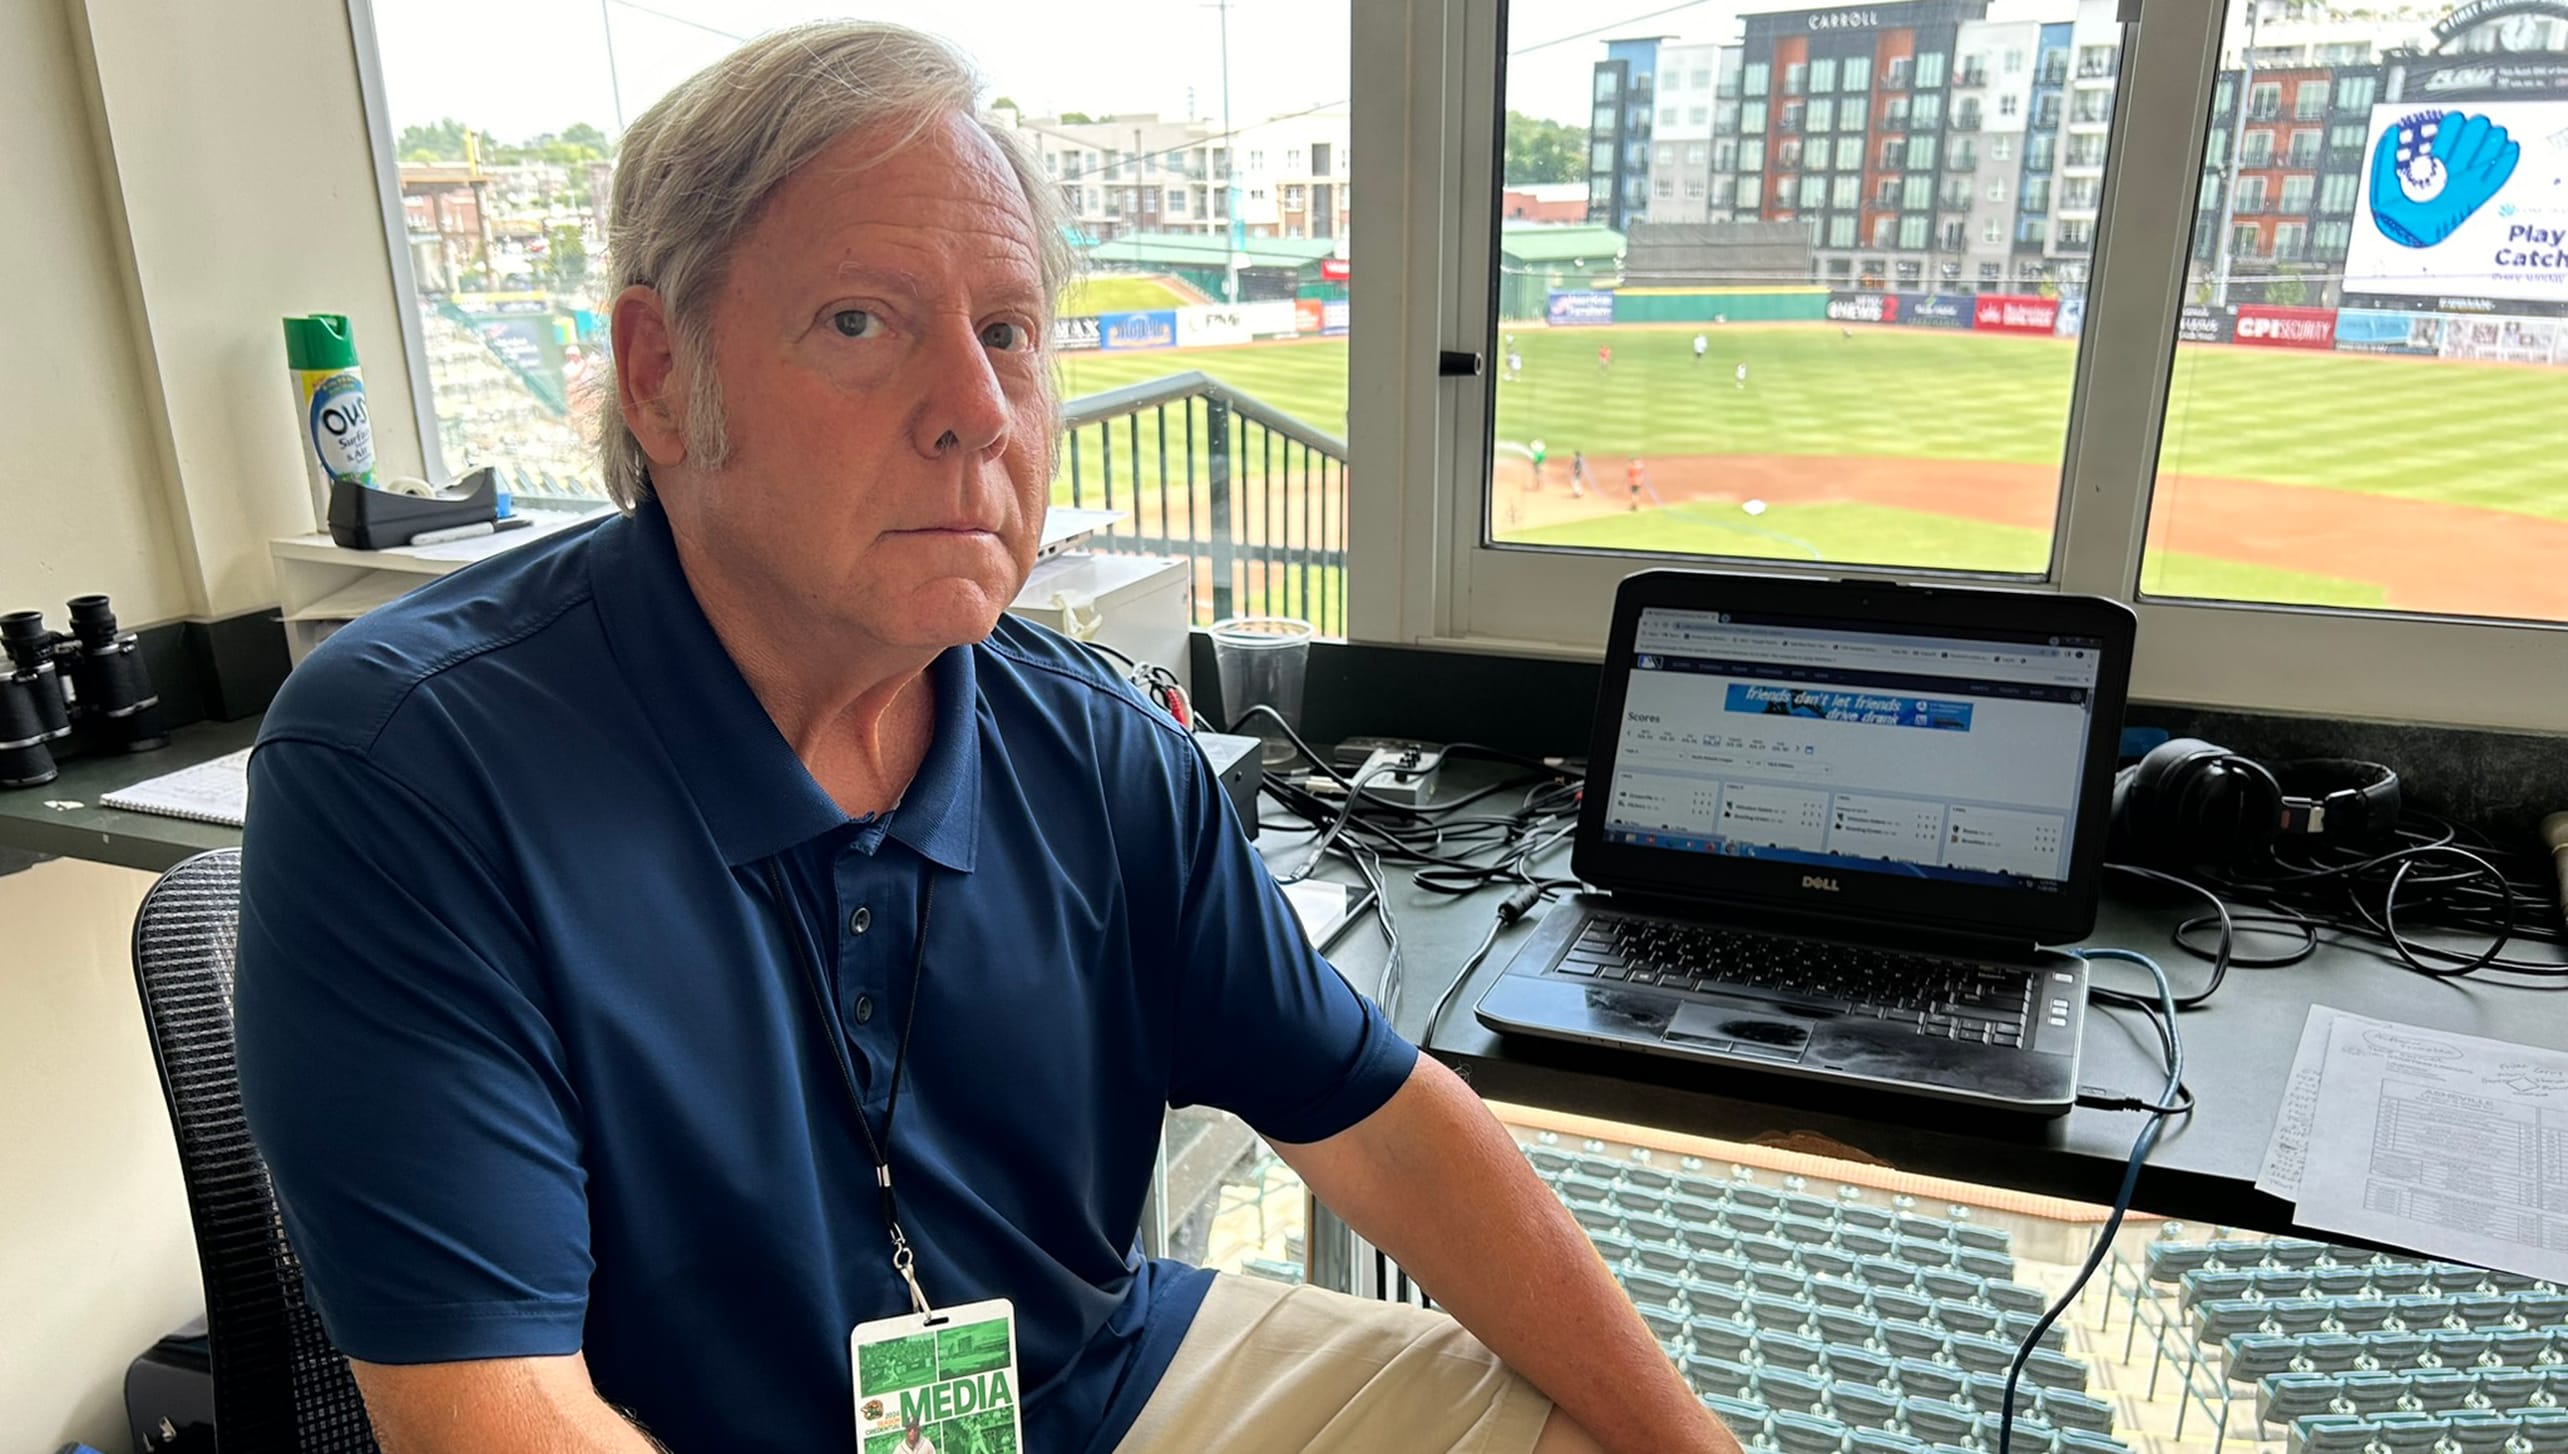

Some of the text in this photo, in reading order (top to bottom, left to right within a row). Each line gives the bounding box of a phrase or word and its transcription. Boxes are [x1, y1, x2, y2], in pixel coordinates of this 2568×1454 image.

[1808, 10, 1879, 30] CARROLL
[2508, 224, 2567, 247] Play
[2494, 248, 2568, 268] Catch
[2237, 317, 2280, 339] CPI
[2279, 319, 2331, 342] SECURITY
[1745, 686, 1792, 703] friends
[1831, 691, 1852, 705] let
[1854, 694, 1902, 712] friends
[1627, 711, 1661, 724] Scores
[1825, 708, 1859, 723] drive
[1801, 875, 1840, 891] DELL
[899, 1371, 1013, 1427] MEDIA
